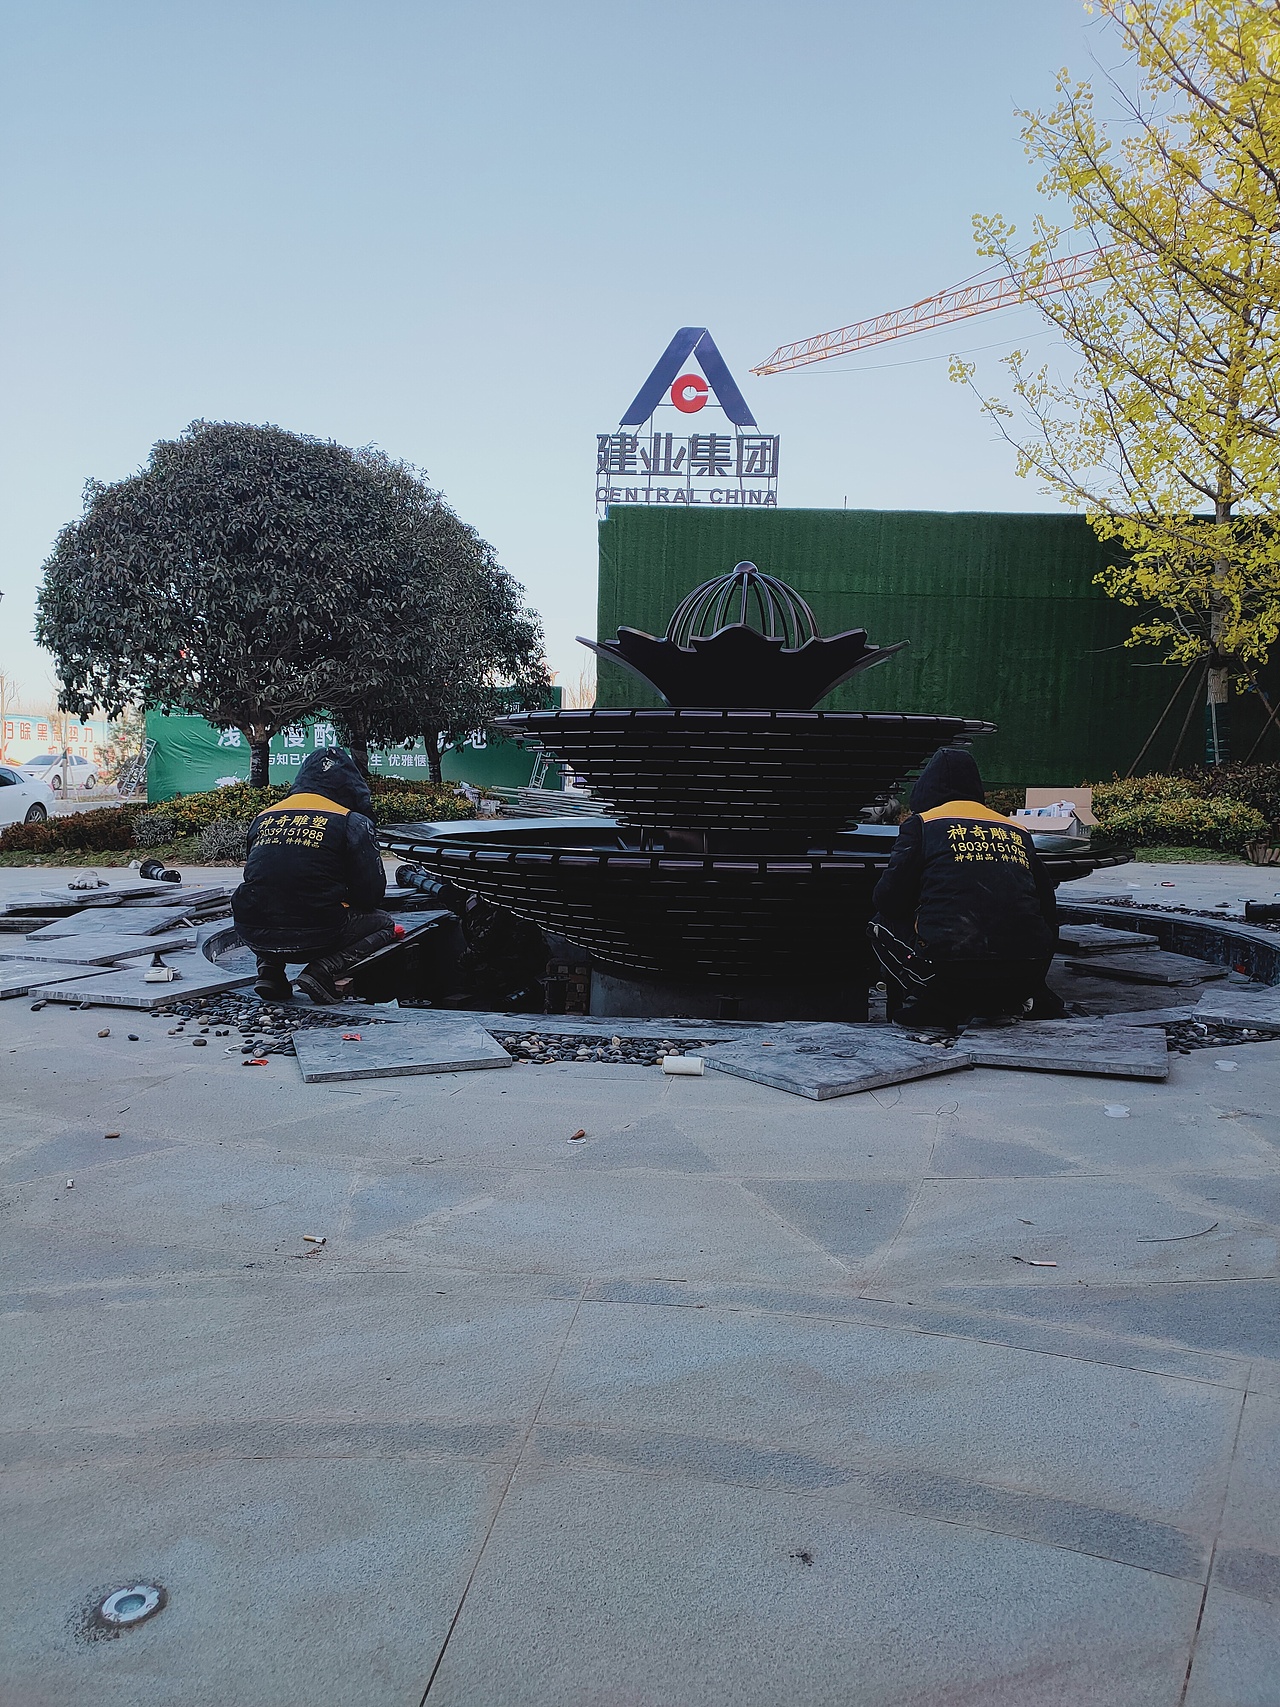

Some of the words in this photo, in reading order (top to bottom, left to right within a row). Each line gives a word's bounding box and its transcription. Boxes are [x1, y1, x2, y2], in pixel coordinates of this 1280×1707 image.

[596, 432, 780, 477] 建业集团
[595, 487, 701, 503] CENTRAL
[709, 488, 777, 504] CHINA
[217, 723, 338, 748] 浅慢酌
[946, 823, 1027, 850] 神奇雕塑
